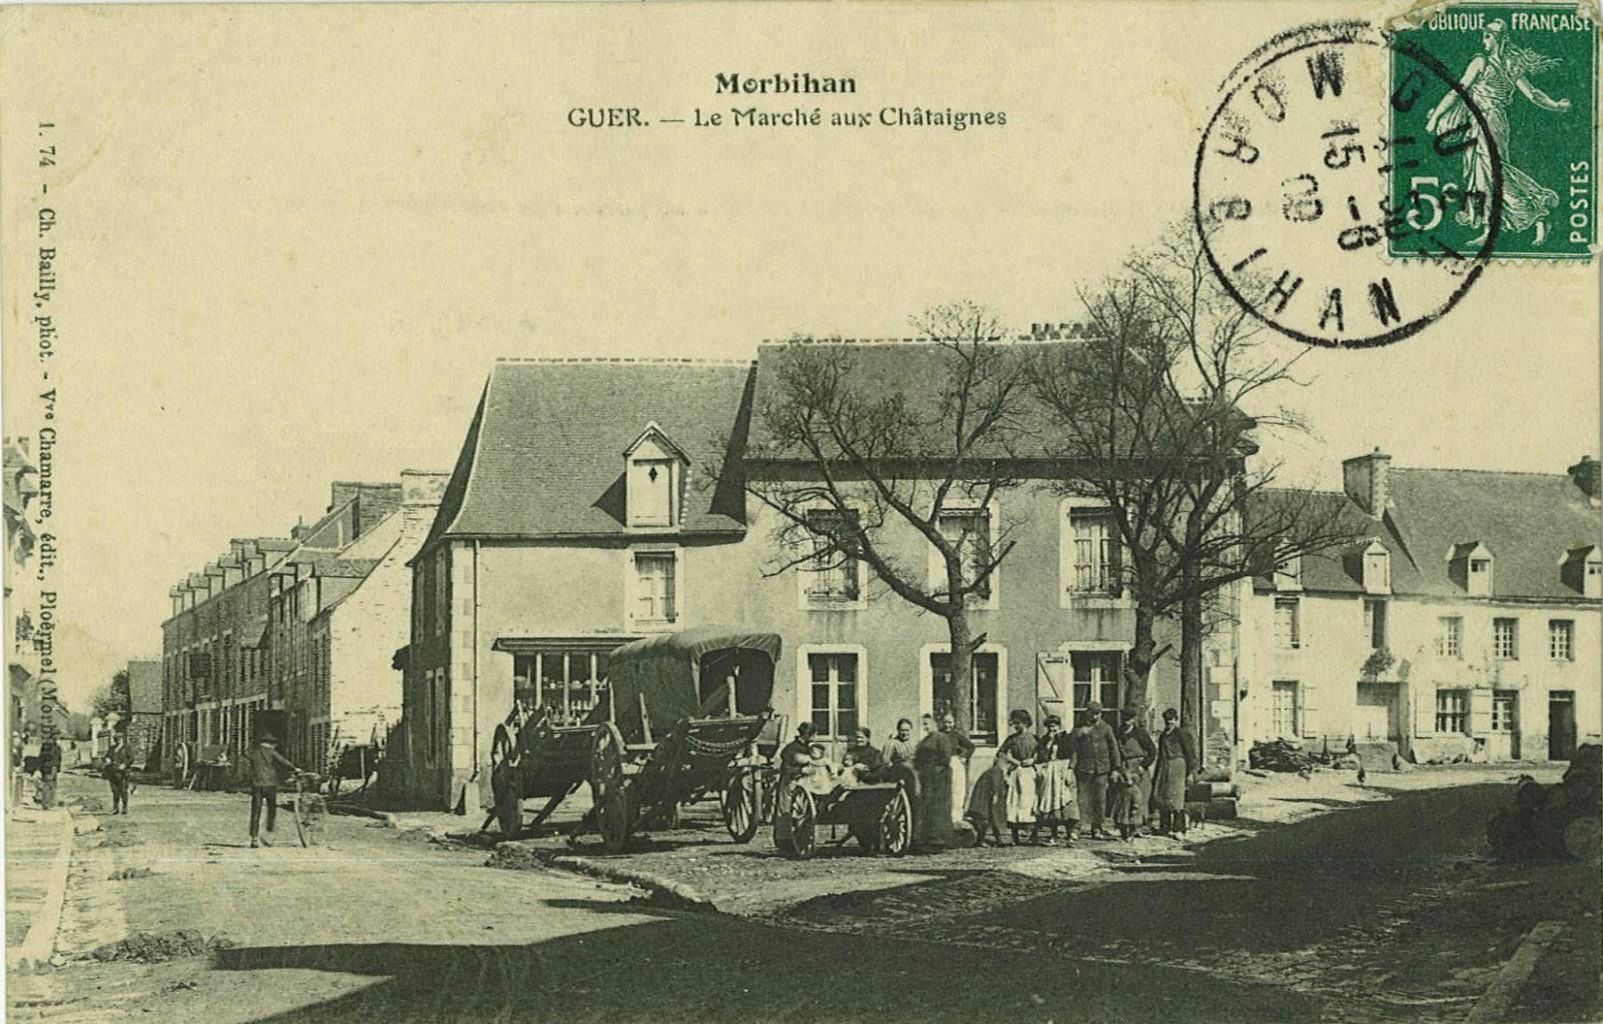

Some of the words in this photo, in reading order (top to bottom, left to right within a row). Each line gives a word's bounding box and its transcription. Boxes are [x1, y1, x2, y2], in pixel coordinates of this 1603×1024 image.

[1429, 12, 1487, 33] UBLIQUE
[1511, 12, 1592, 33] FRANÇAISE
[1320, 119, 1366, 170] 15
[1569, 160, 1590, 244] POSTES
